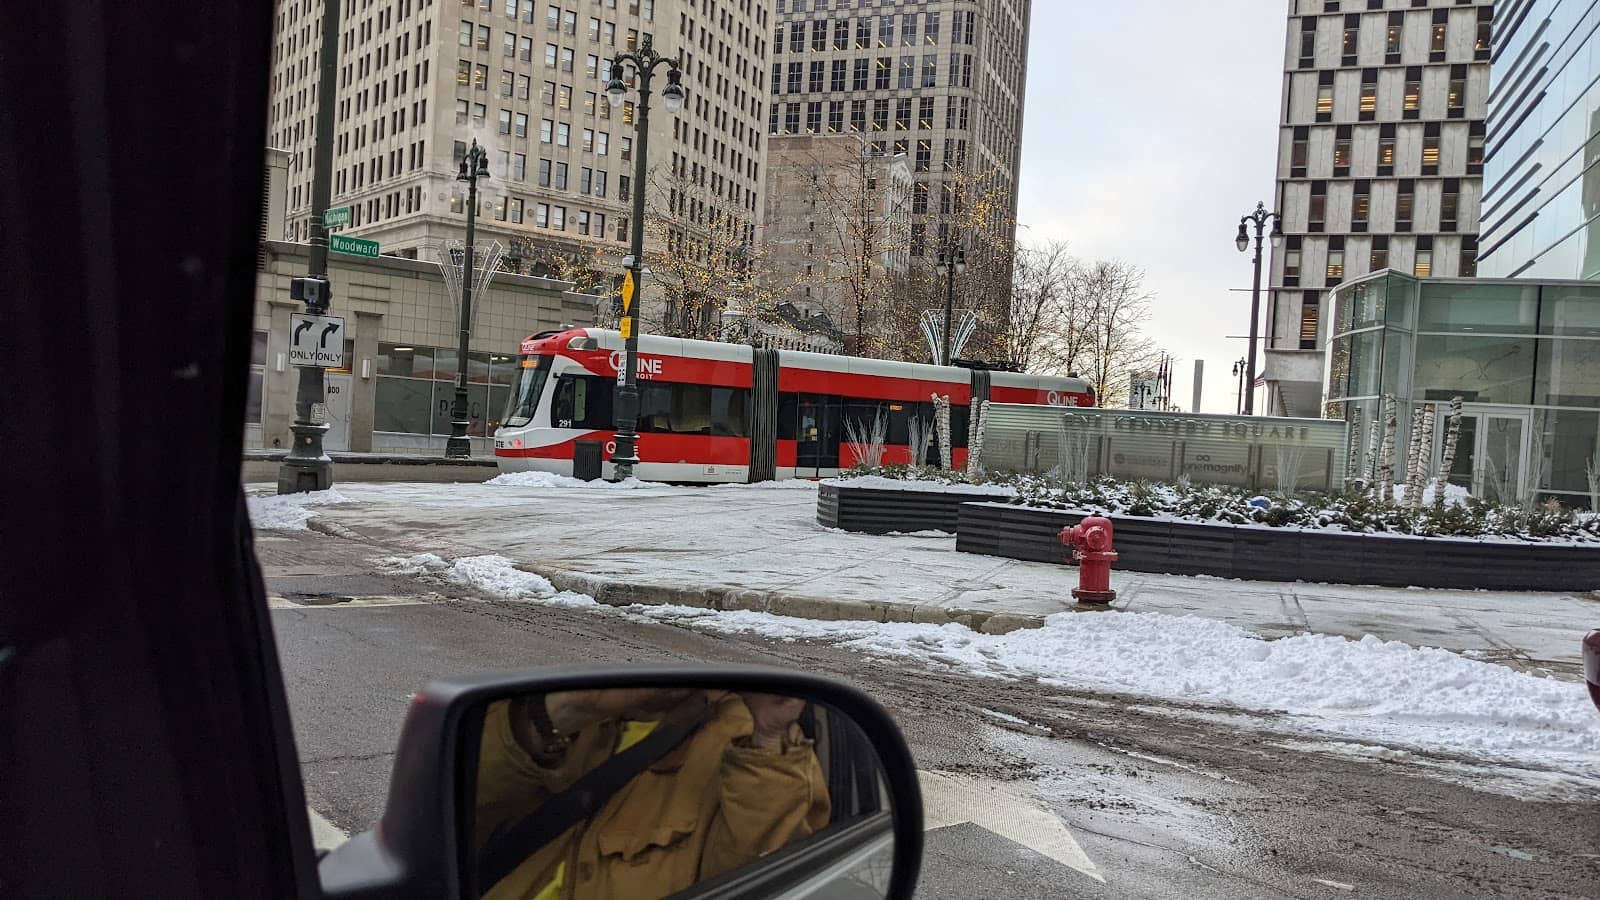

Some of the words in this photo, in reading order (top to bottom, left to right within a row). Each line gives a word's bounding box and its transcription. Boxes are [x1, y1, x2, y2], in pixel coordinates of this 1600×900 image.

[324, 211, 348, 225] Michigan
[332, 237, 378, 255] Woodward
[290, 350, 315, 360] ONLY
[317, 352, 341, 361] ONLY
[1047, 391, 1078, 407] QLINE
[559, 419, 572, 428] 291
[1114, 415, 1212, 434] KENNEDY
[1223, 421, 1309, 440] SQUARE
